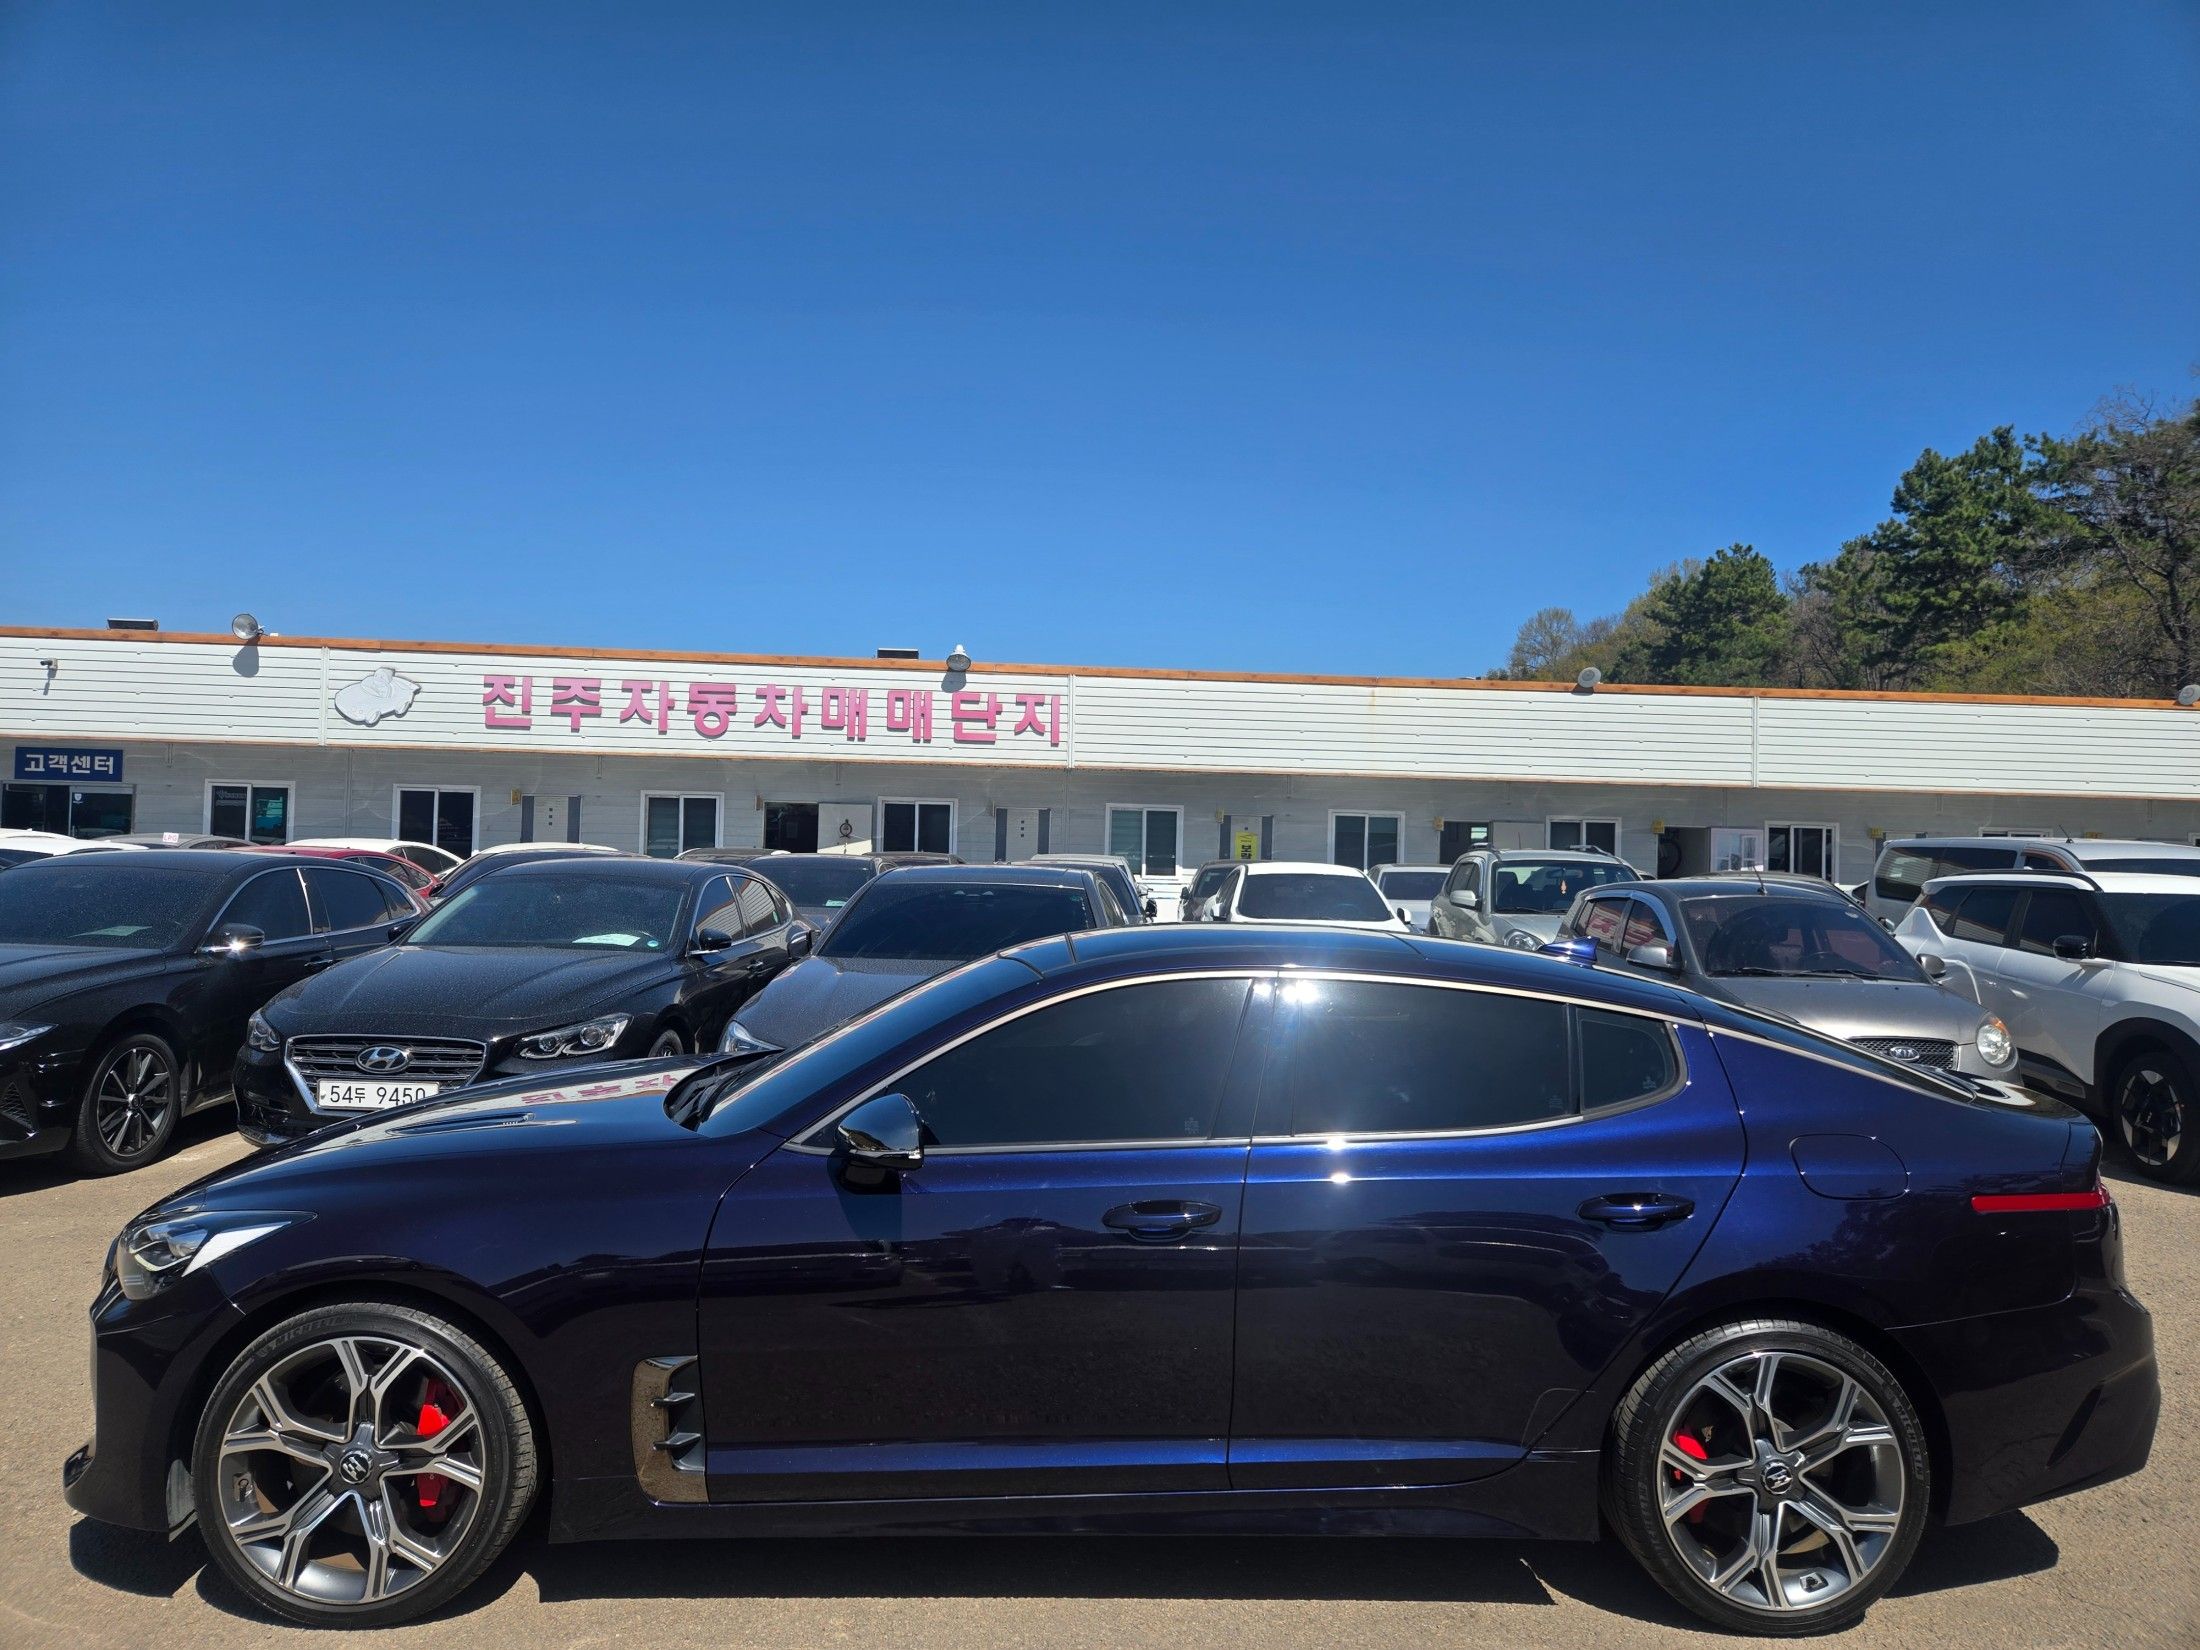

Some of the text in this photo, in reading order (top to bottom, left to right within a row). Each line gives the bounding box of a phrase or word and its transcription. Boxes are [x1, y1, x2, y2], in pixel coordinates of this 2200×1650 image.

[482, 674, 1061, 745] 진주자동차매매단지
[24, 754, 115, 775] 고객센터
[329, 1085, 426, 1106] 54두 9450
